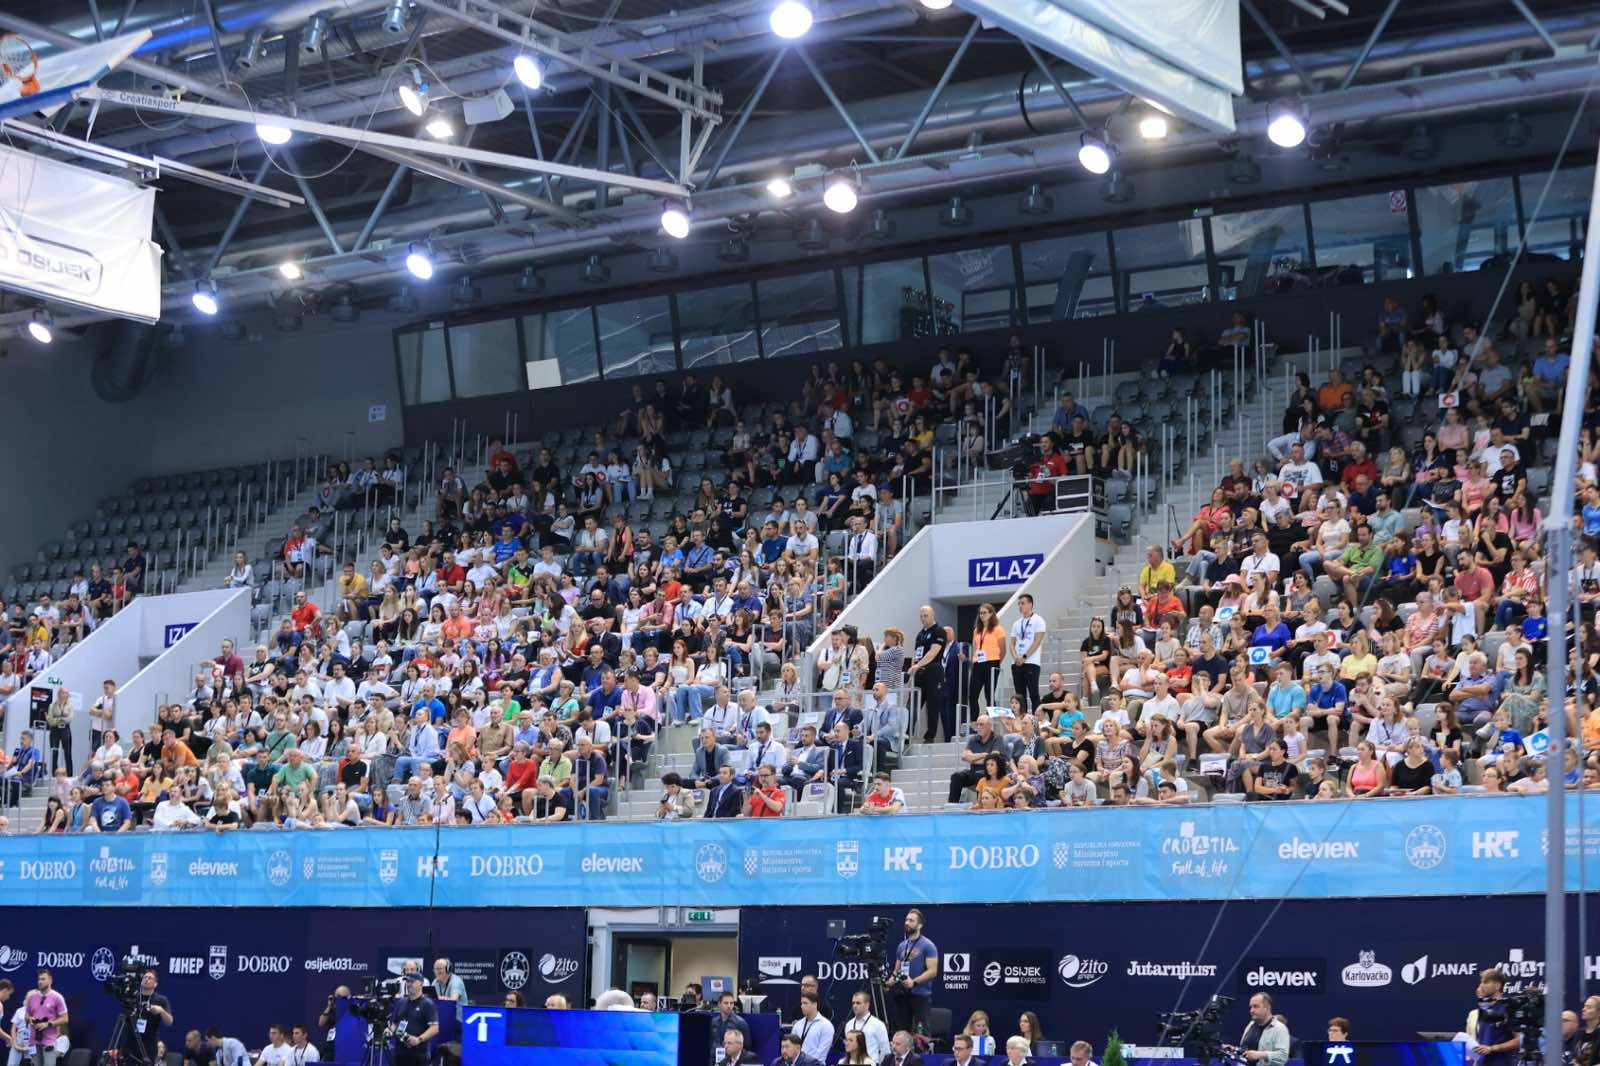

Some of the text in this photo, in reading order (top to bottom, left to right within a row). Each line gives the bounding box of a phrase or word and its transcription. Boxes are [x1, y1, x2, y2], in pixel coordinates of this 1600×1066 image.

[976, 558, 1036, 583] IZLAZ
[1472, 831, 1519, 859] HRT
[470, 854, 544, 877] DOBRO
[884, 846, 923, 871] HRT
[949, 844, 1040, 869] DOBRO
[20, 860, 76, 880] DOBRO
[37, 951, 84, 969] DOBRO
[181, 957, 204, 975] HEP
[237, 955, 291, 973] DOBRO
[304, 957, 369, 973] osijek031.com
[555, 957, 579, 972] žito
[1079, 958, 1109, 974] žito
[816, 961, 869, 980] DOBR
[1004, 966, 1041, 977] OSIJEK
[1431, 962, 1479, 978] JANAF
